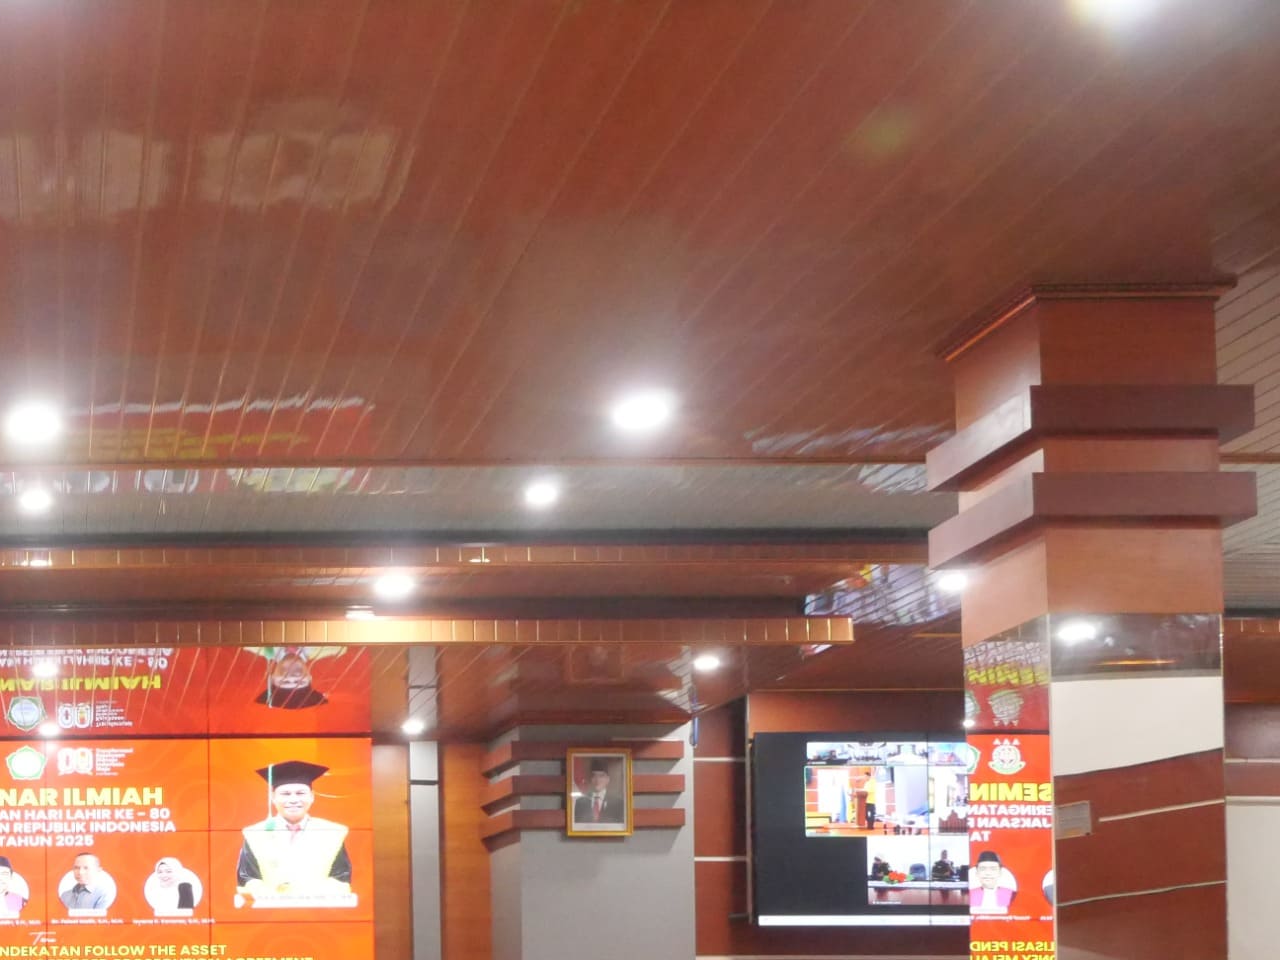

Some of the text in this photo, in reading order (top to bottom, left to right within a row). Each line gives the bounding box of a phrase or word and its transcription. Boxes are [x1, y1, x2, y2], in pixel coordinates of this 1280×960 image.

[63, 787, 163, 805] ILMIAH
[24, 809, 63, 821] HARI
[66, 809, 111, 820] LAHIR
[115, 808, 134, 819] KE
[149, 808, 170, 819] 80
[13, 822, 86, 834] REPUBLIK
[90, 820, 176, 832] INDONESIA
[56, 834, 94, 846] 2025
[85, 945, 145, 956] FOLLOW
[149, 945, 176, 956] THE
[180, 944, 227, 956] ASSET
